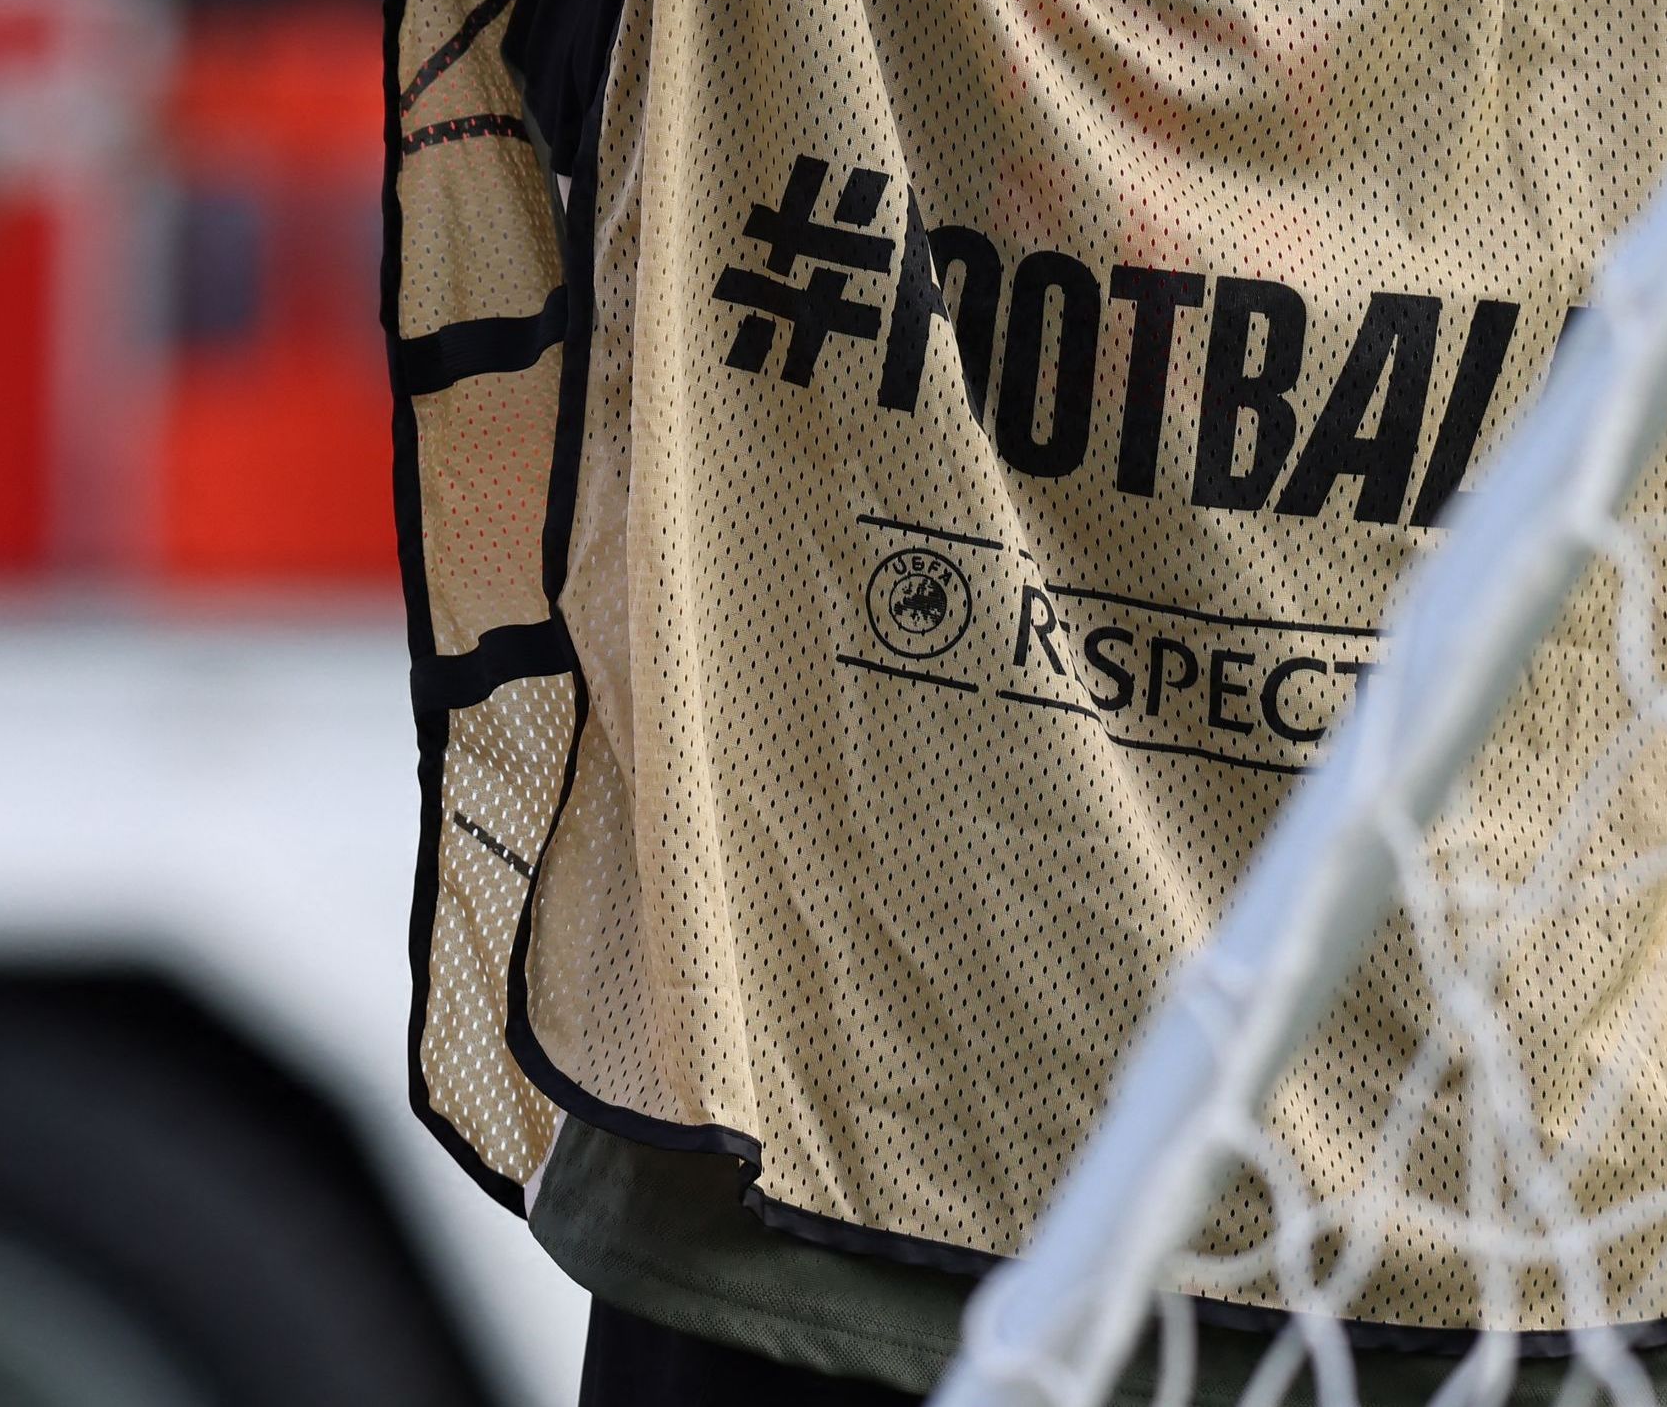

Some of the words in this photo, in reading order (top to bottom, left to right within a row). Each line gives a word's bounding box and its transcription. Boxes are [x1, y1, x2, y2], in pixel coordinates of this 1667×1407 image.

[712, 153, 1594, 529] #FOOTBAL
[892, 554, 953, 587] UEFA
[1012, 583, 1382, 743] RSPECT
